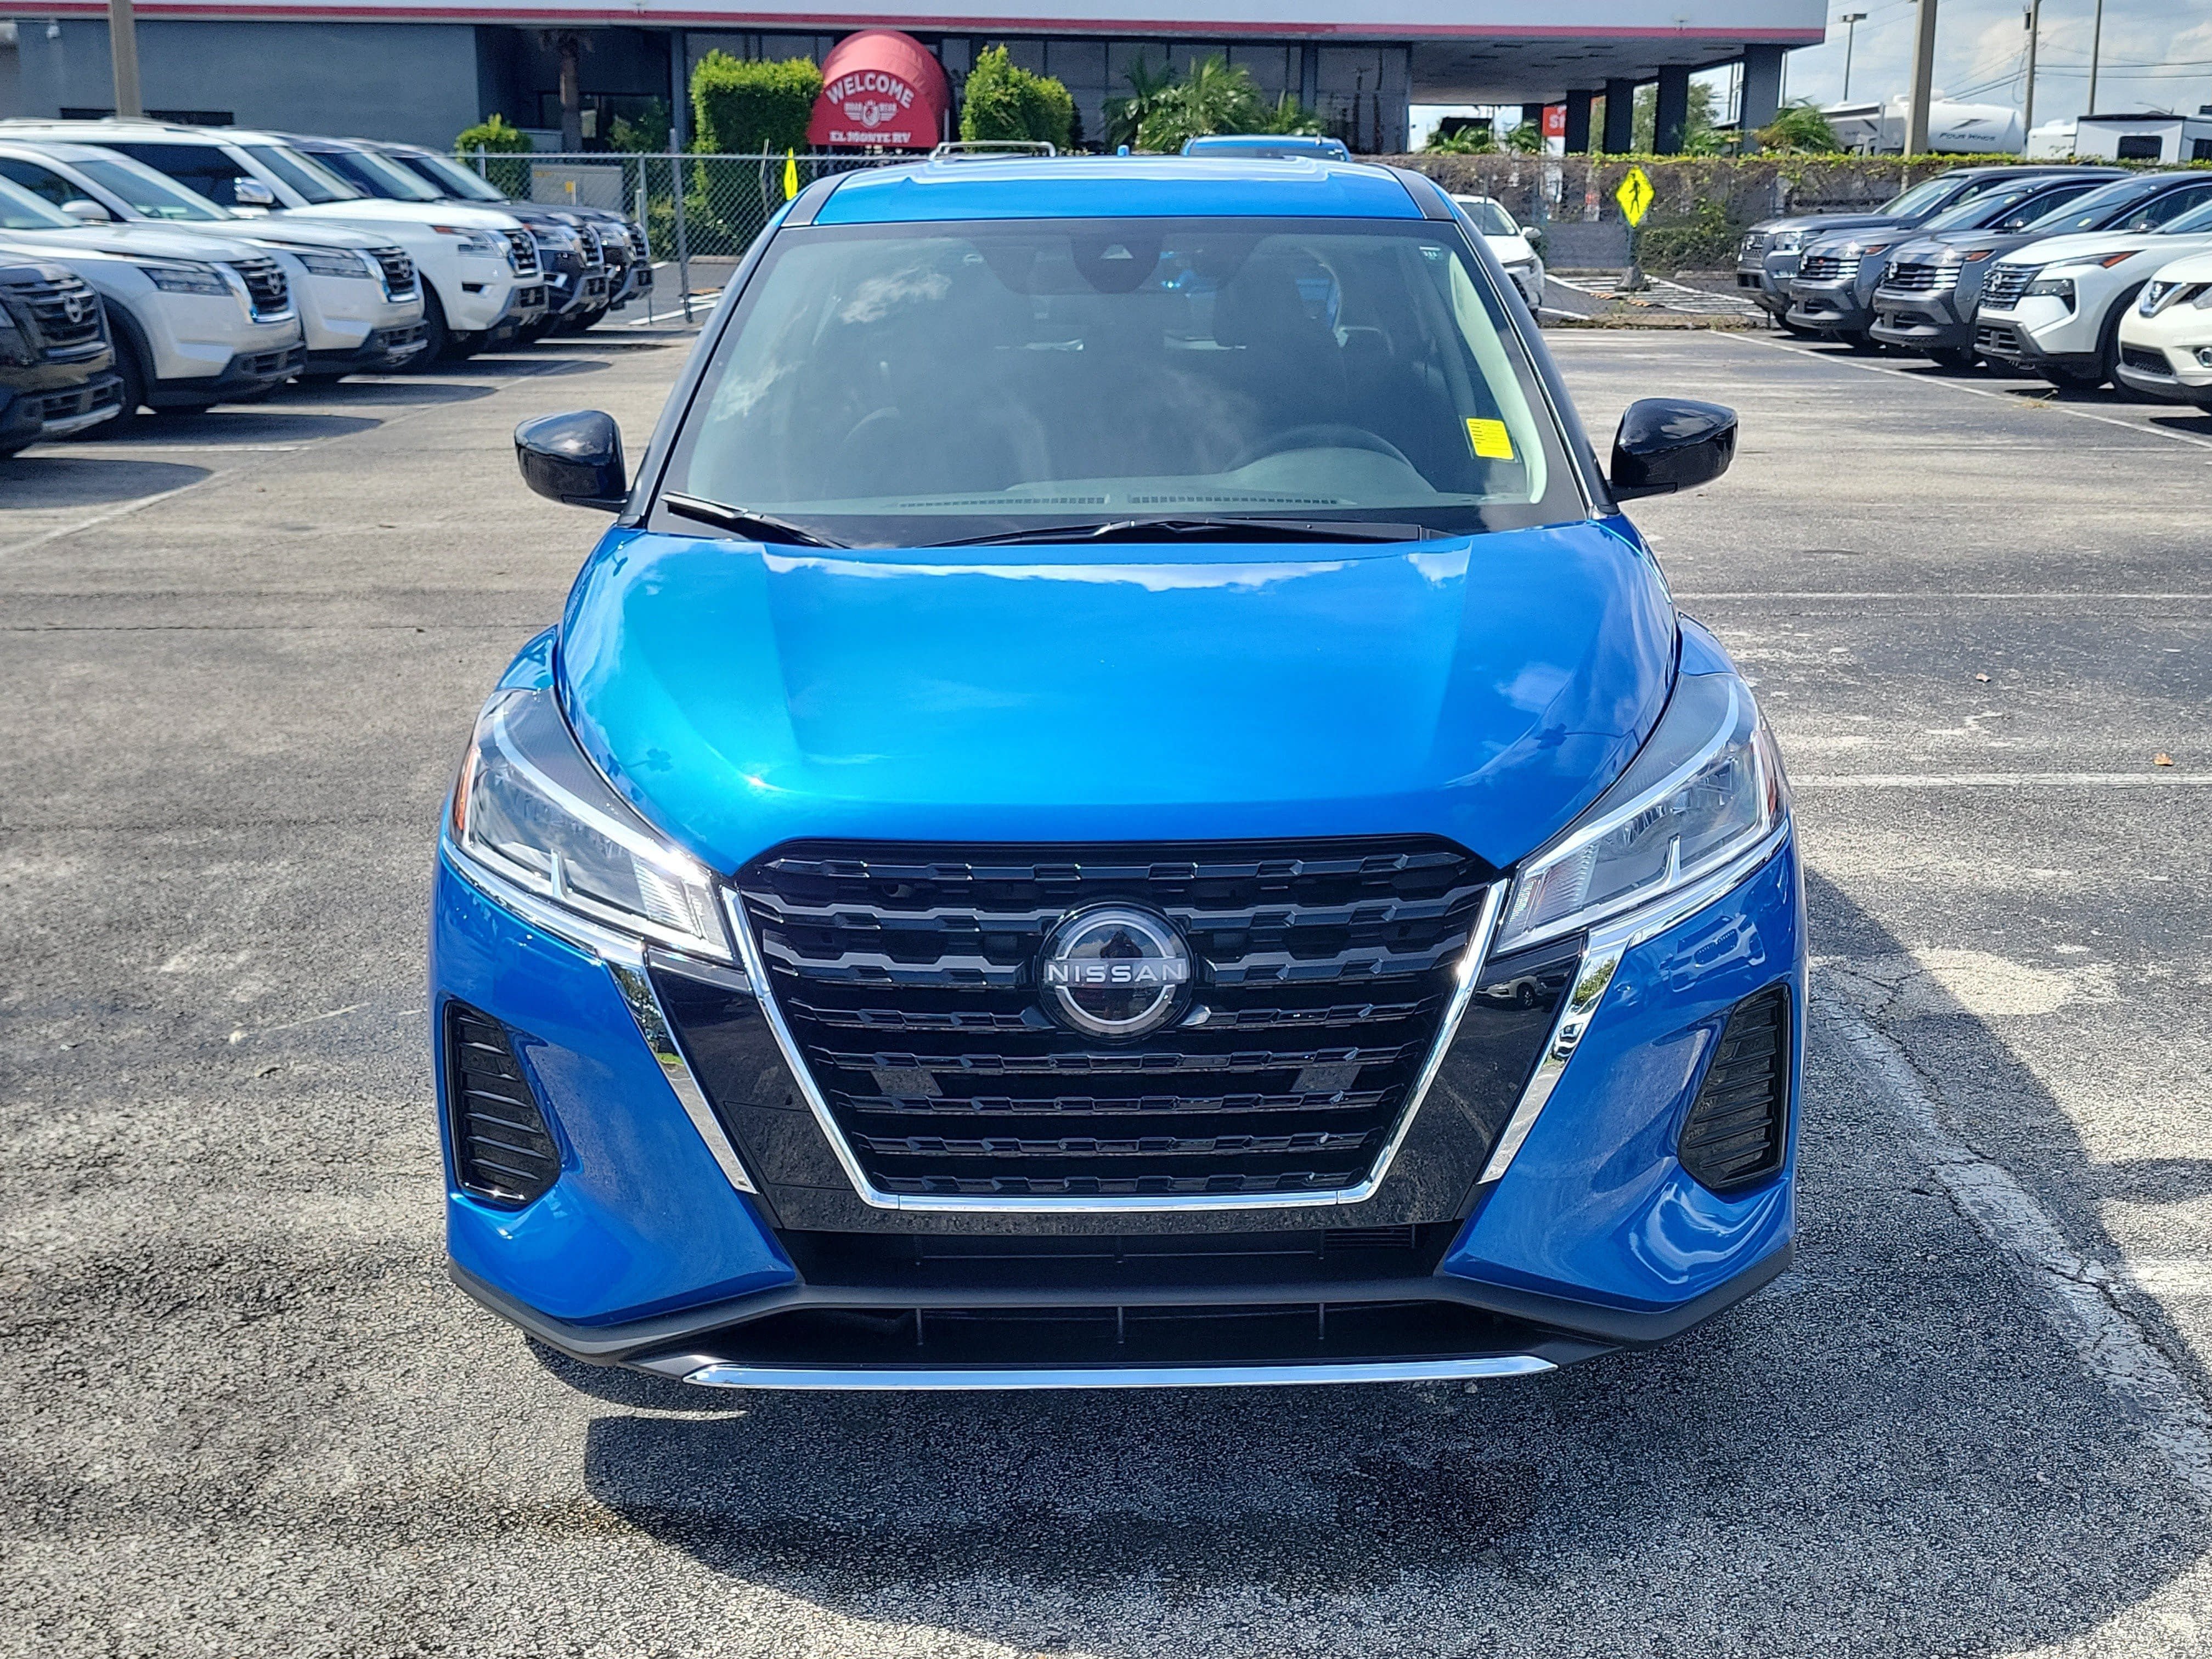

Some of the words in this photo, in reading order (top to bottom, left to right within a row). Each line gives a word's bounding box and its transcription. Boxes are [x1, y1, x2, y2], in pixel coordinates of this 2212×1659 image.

[826, 72, 915, 109] WELCOME
[830, 130, 846, 142] EL
[847, 131, 891, 143] MONTE
[892, 132, 911, 143] RV
[1048, 963, 1182, 983] NISSAN
